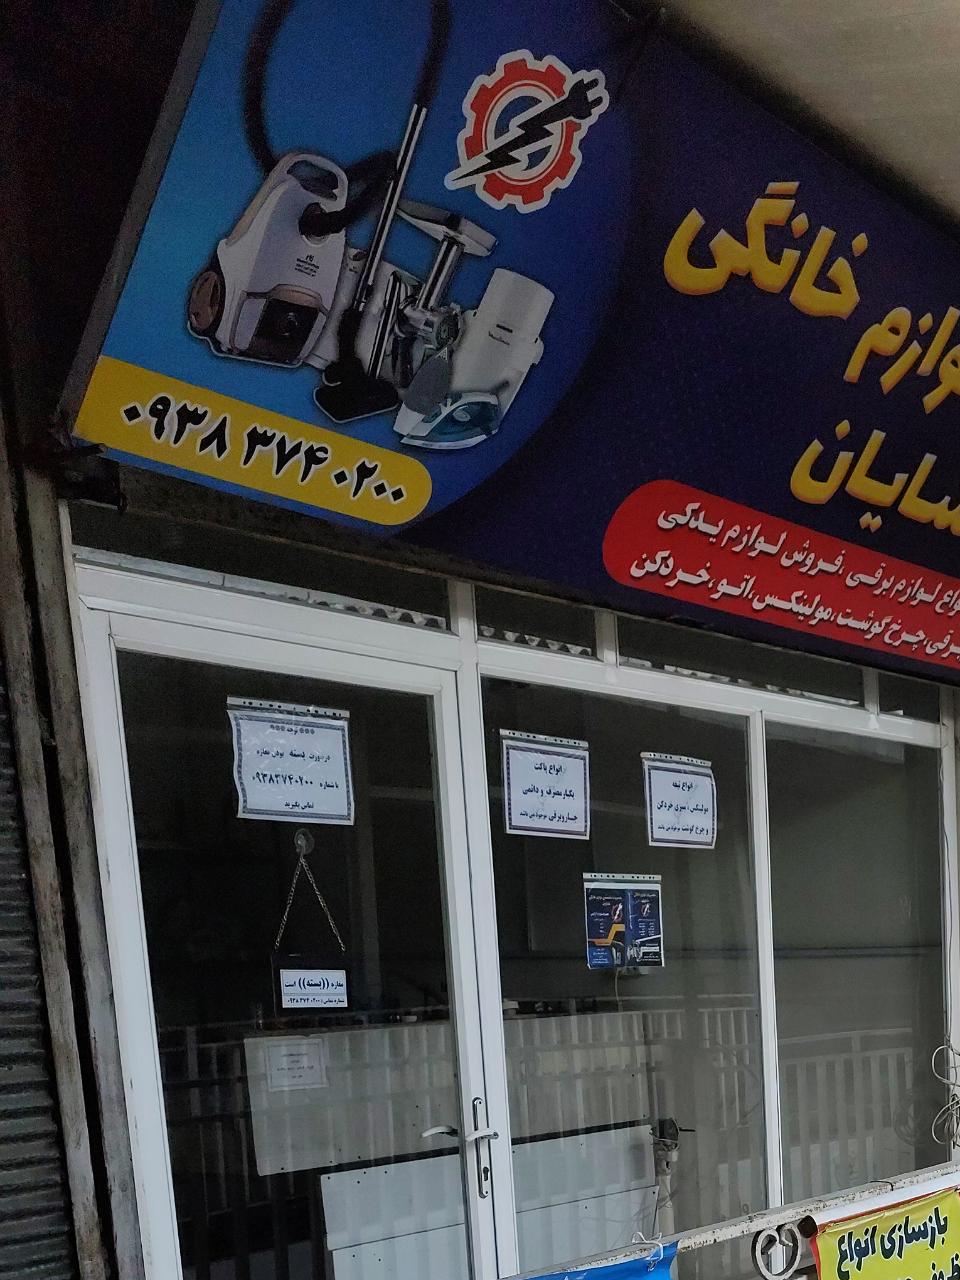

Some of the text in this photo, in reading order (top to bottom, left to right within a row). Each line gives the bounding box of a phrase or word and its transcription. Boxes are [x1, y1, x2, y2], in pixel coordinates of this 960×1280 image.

[663, 181, 869, 319] خانگی
[657, 503, 724, 543] یدکی
[721, 523, 787, 557] لوازم
[845, 563, 894, 595] برقی
[890, 576, 942, 606] لوازم
[880, 1206, 949, 1261] بازسازی
